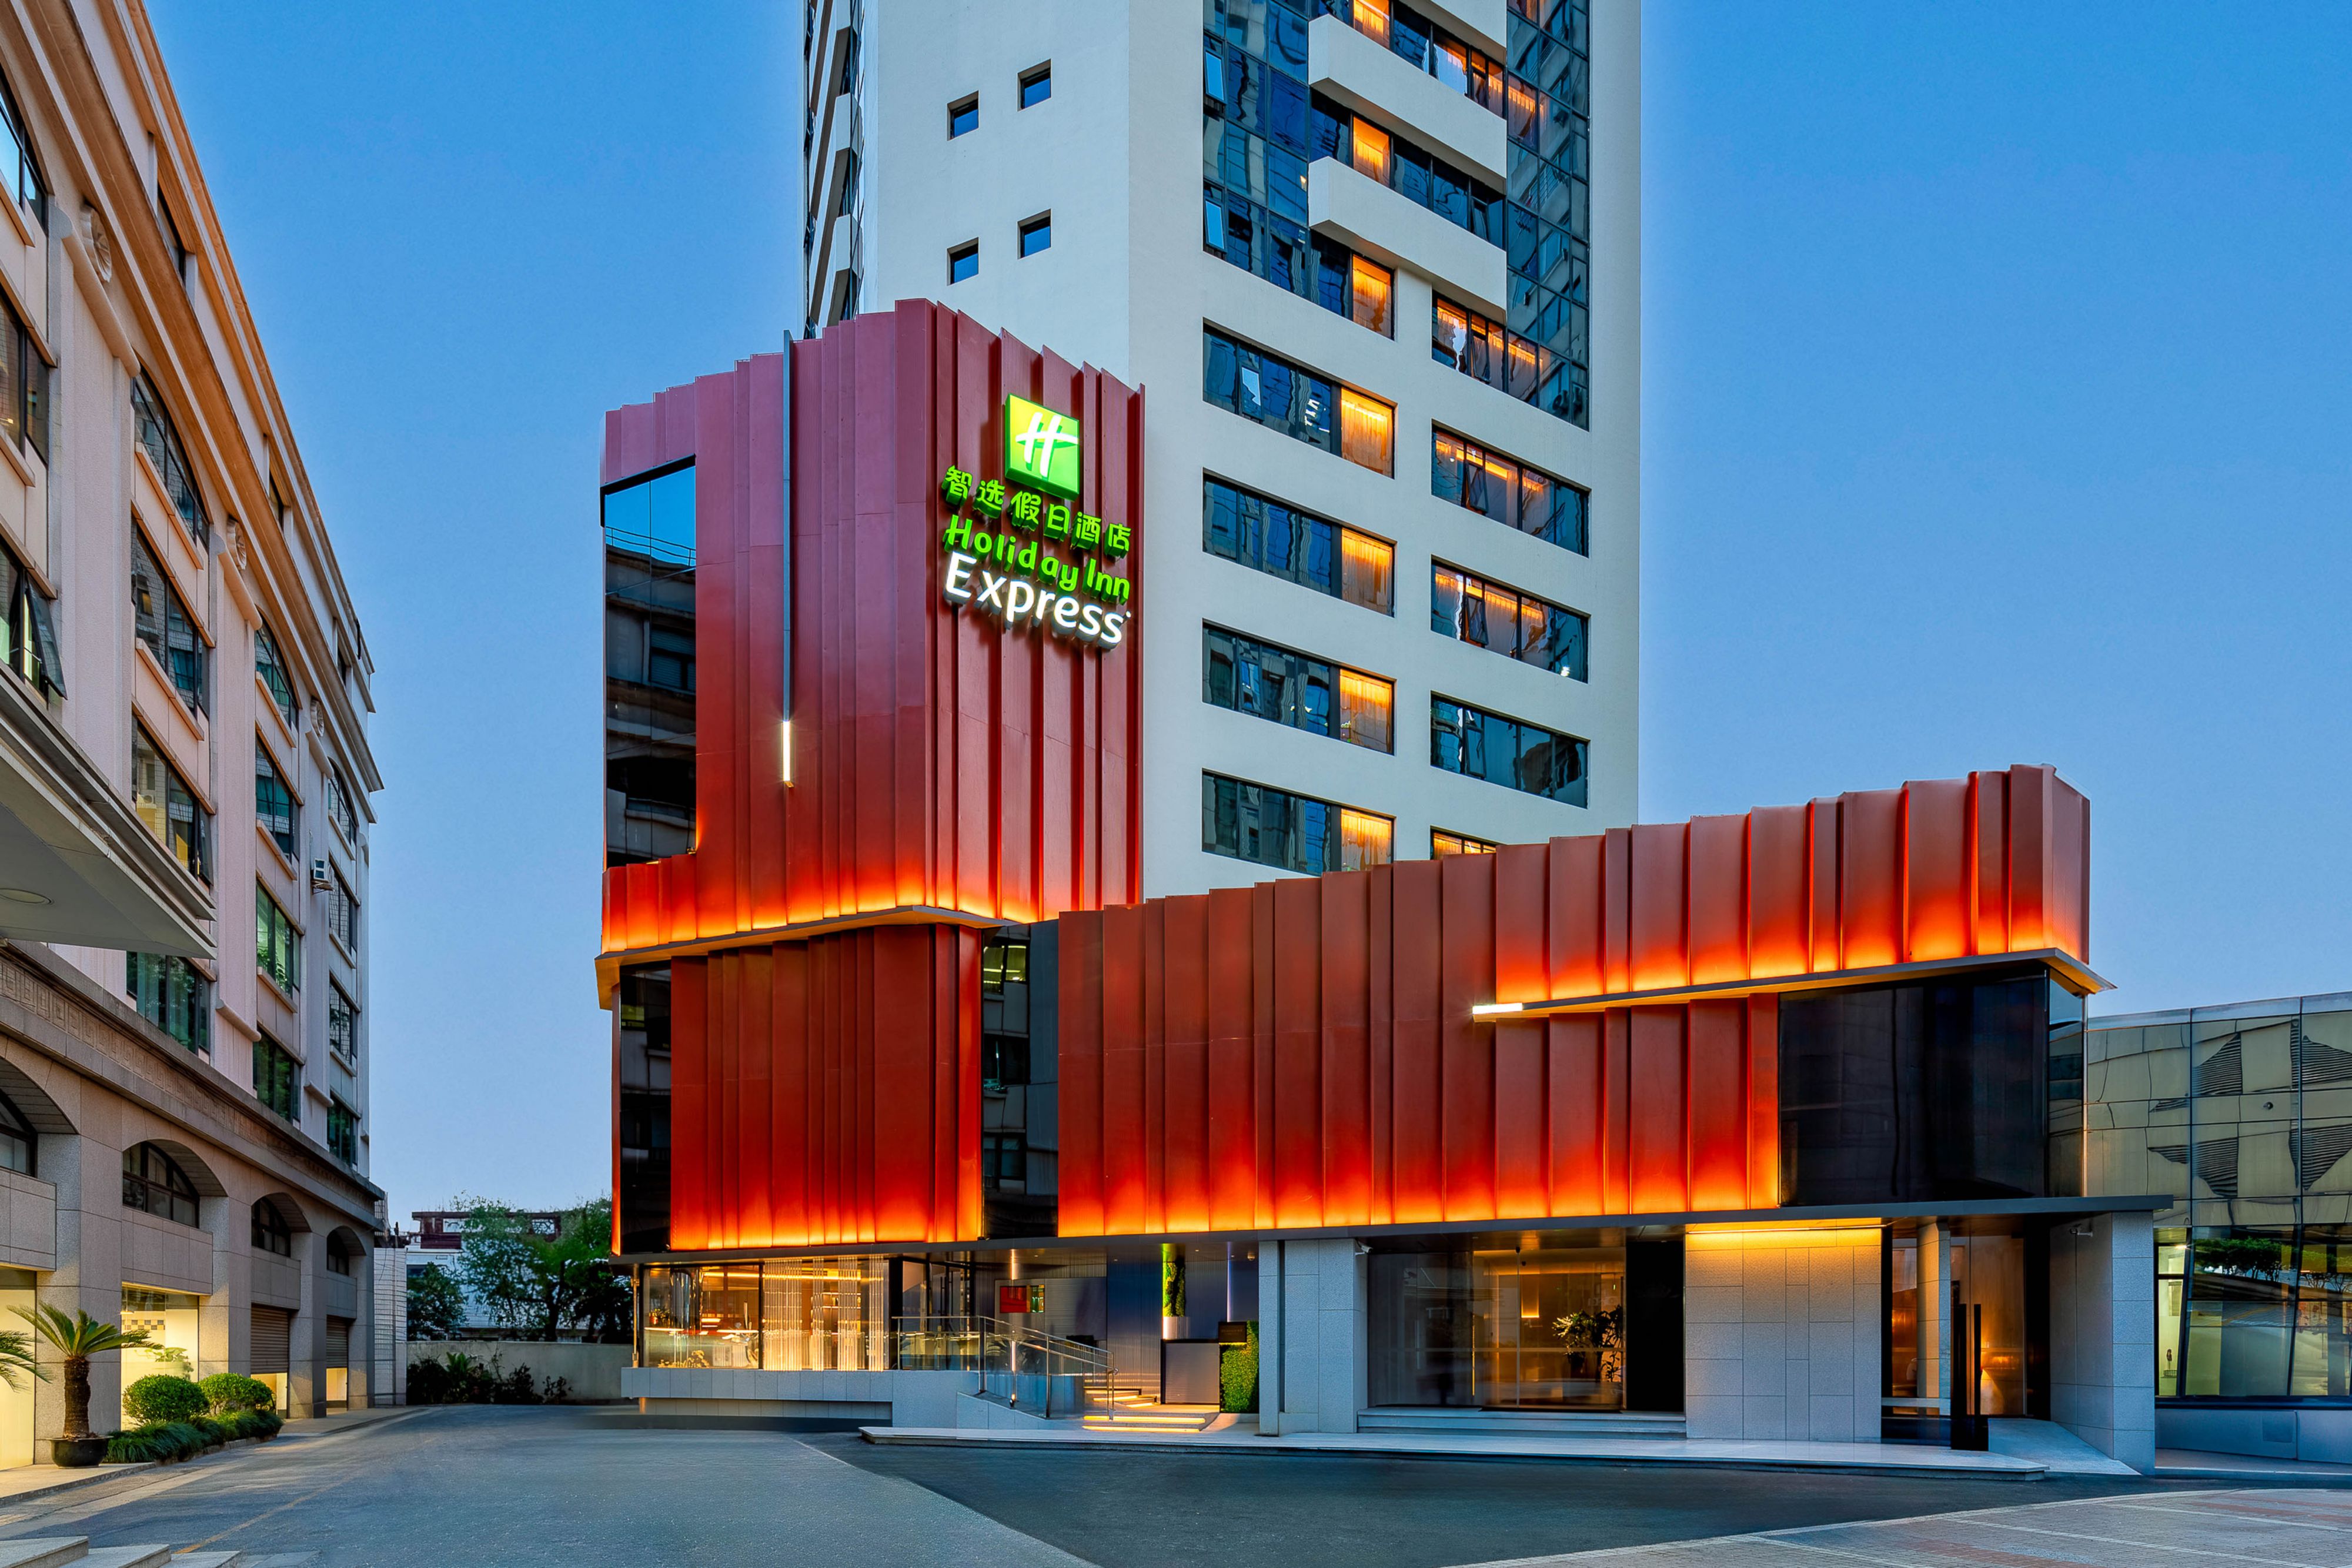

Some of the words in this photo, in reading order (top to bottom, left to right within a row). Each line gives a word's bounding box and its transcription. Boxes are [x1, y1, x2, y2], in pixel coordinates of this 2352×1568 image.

[944, 465, 1131, 551] 智选假日酒店
[946, 514, 1079, 591] Holiday
[1087, 558, 1130, 600] Inn
[946, 551, 1124, 644] Express
